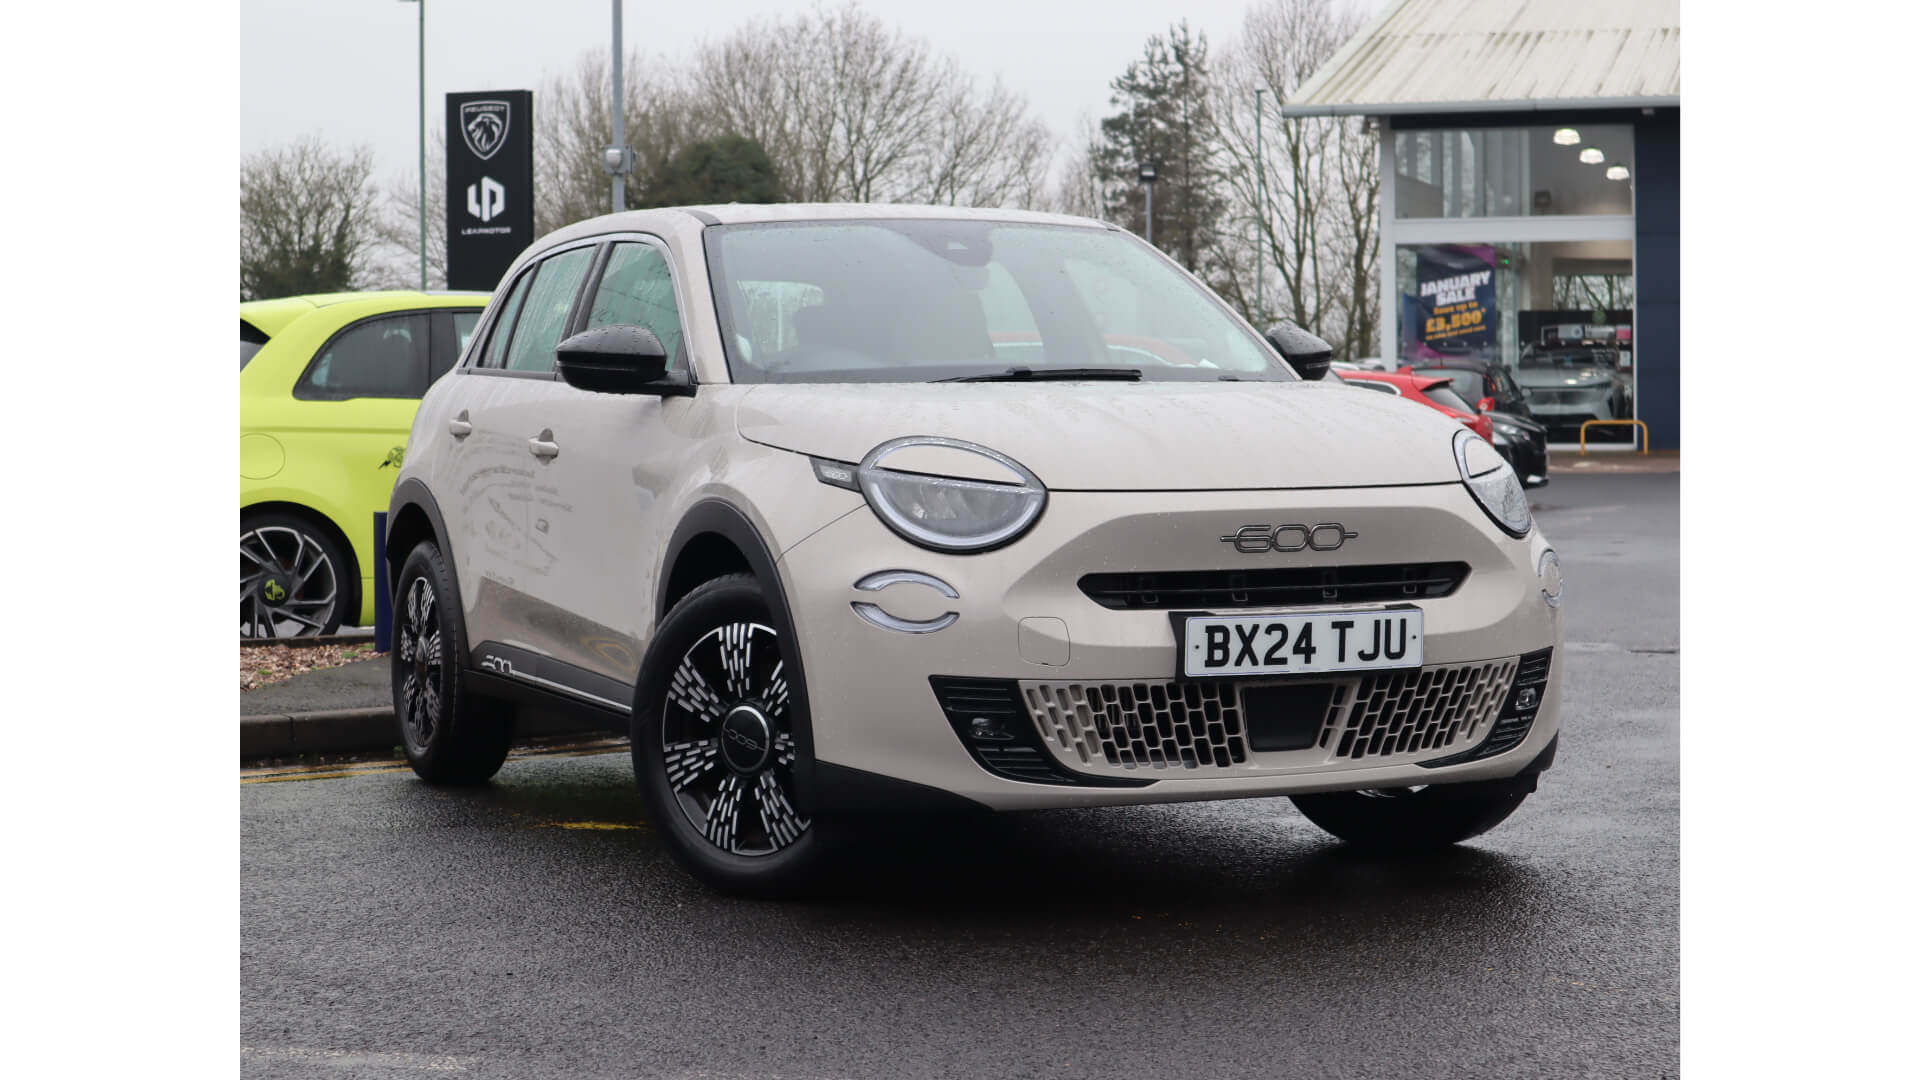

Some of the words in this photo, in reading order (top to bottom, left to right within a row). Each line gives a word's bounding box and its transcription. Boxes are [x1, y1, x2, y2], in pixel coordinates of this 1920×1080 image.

[464, 105, 505, 113] PEUGEOT
[461, 227, 511, 235] LEAPMOTOR
[1420, 270, 1491, 296] JANUARY
[1436, 288, 1476, 306] SALE
[1232, 523, 1347, 553] 600
[1204, 622, 1316, 667] BX24
[1331, 618, 1407, 662] TJU
